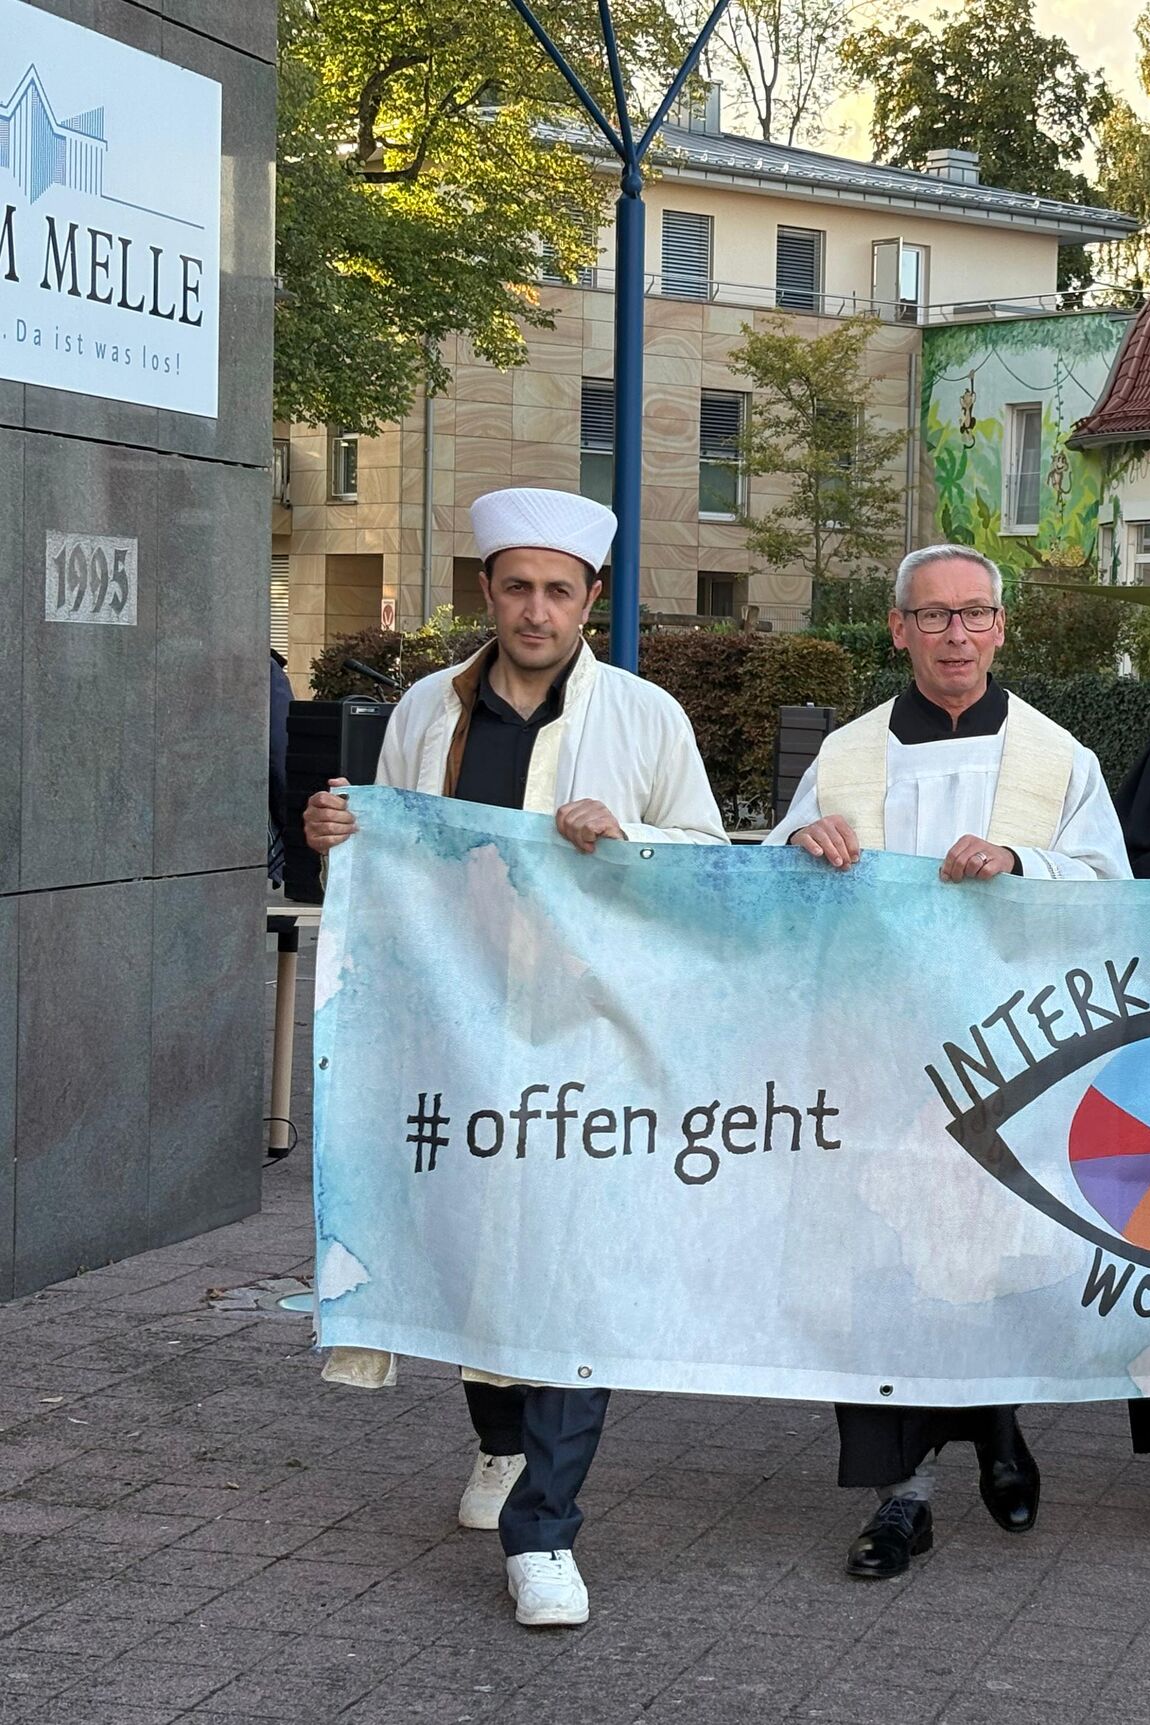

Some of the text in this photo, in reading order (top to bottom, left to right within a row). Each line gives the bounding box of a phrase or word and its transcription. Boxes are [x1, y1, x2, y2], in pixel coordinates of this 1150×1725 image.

[40, 215, 204, 327] MELLE
[16, 318, 181, 375] Da ist was los!
[52, 542, 129, 616] 1995
[406, 1080, 842, 1186] #offen geht
